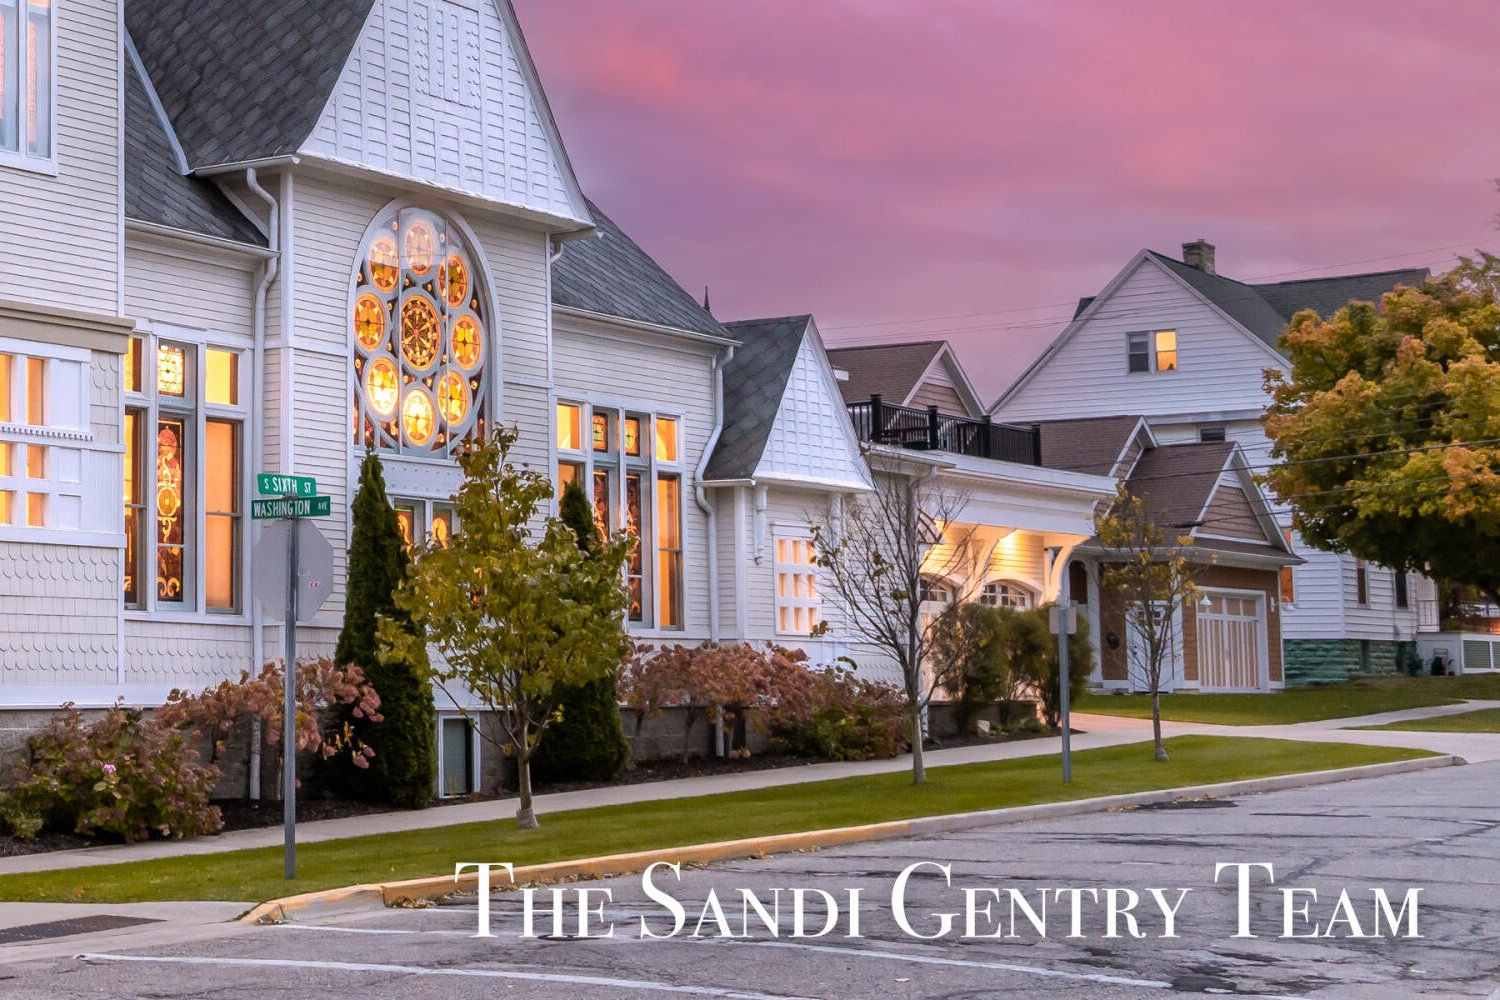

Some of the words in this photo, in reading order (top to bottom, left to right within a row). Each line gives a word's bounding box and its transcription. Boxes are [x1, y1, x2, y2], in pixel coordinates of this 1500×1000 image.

[264, 478, 269, 489] S
[272, 477, 297, 493] SIXTH
[304, 482, 311, 493] ST
[253, 500, 310, 517] WASHINGTON
[318, 502, 327, 510] AVE
